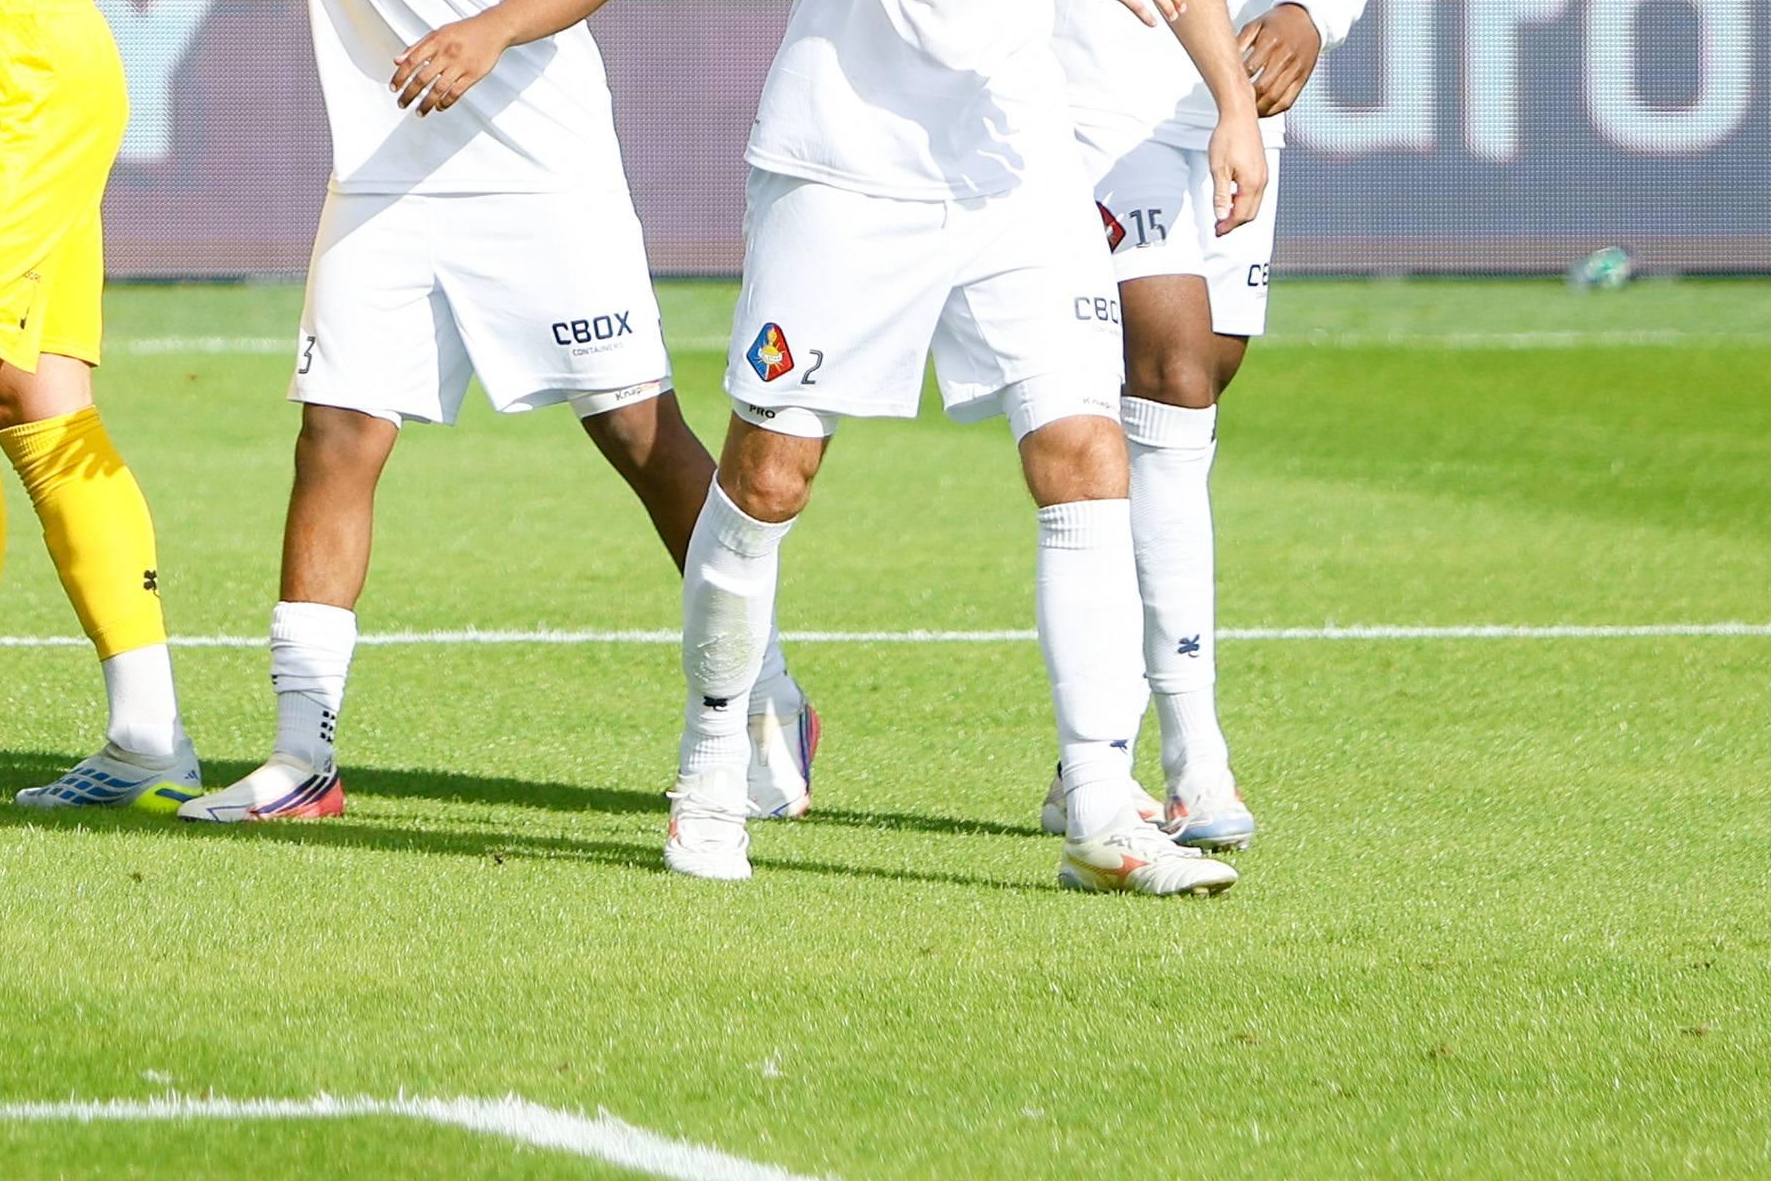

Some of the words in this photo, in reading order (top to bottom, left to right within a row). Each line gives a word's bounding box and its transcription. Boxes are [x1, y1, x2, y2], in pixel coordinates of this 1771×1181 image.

[1129, 209, 1166, 249] 15
[552, 310, 633, 346] CBOX
[1074, 296, 1120, 325] CBO
[298, 335, 316, 374] 3
[801, 349, 823, 385] 2
[749, 404, 776, 419] PRO
